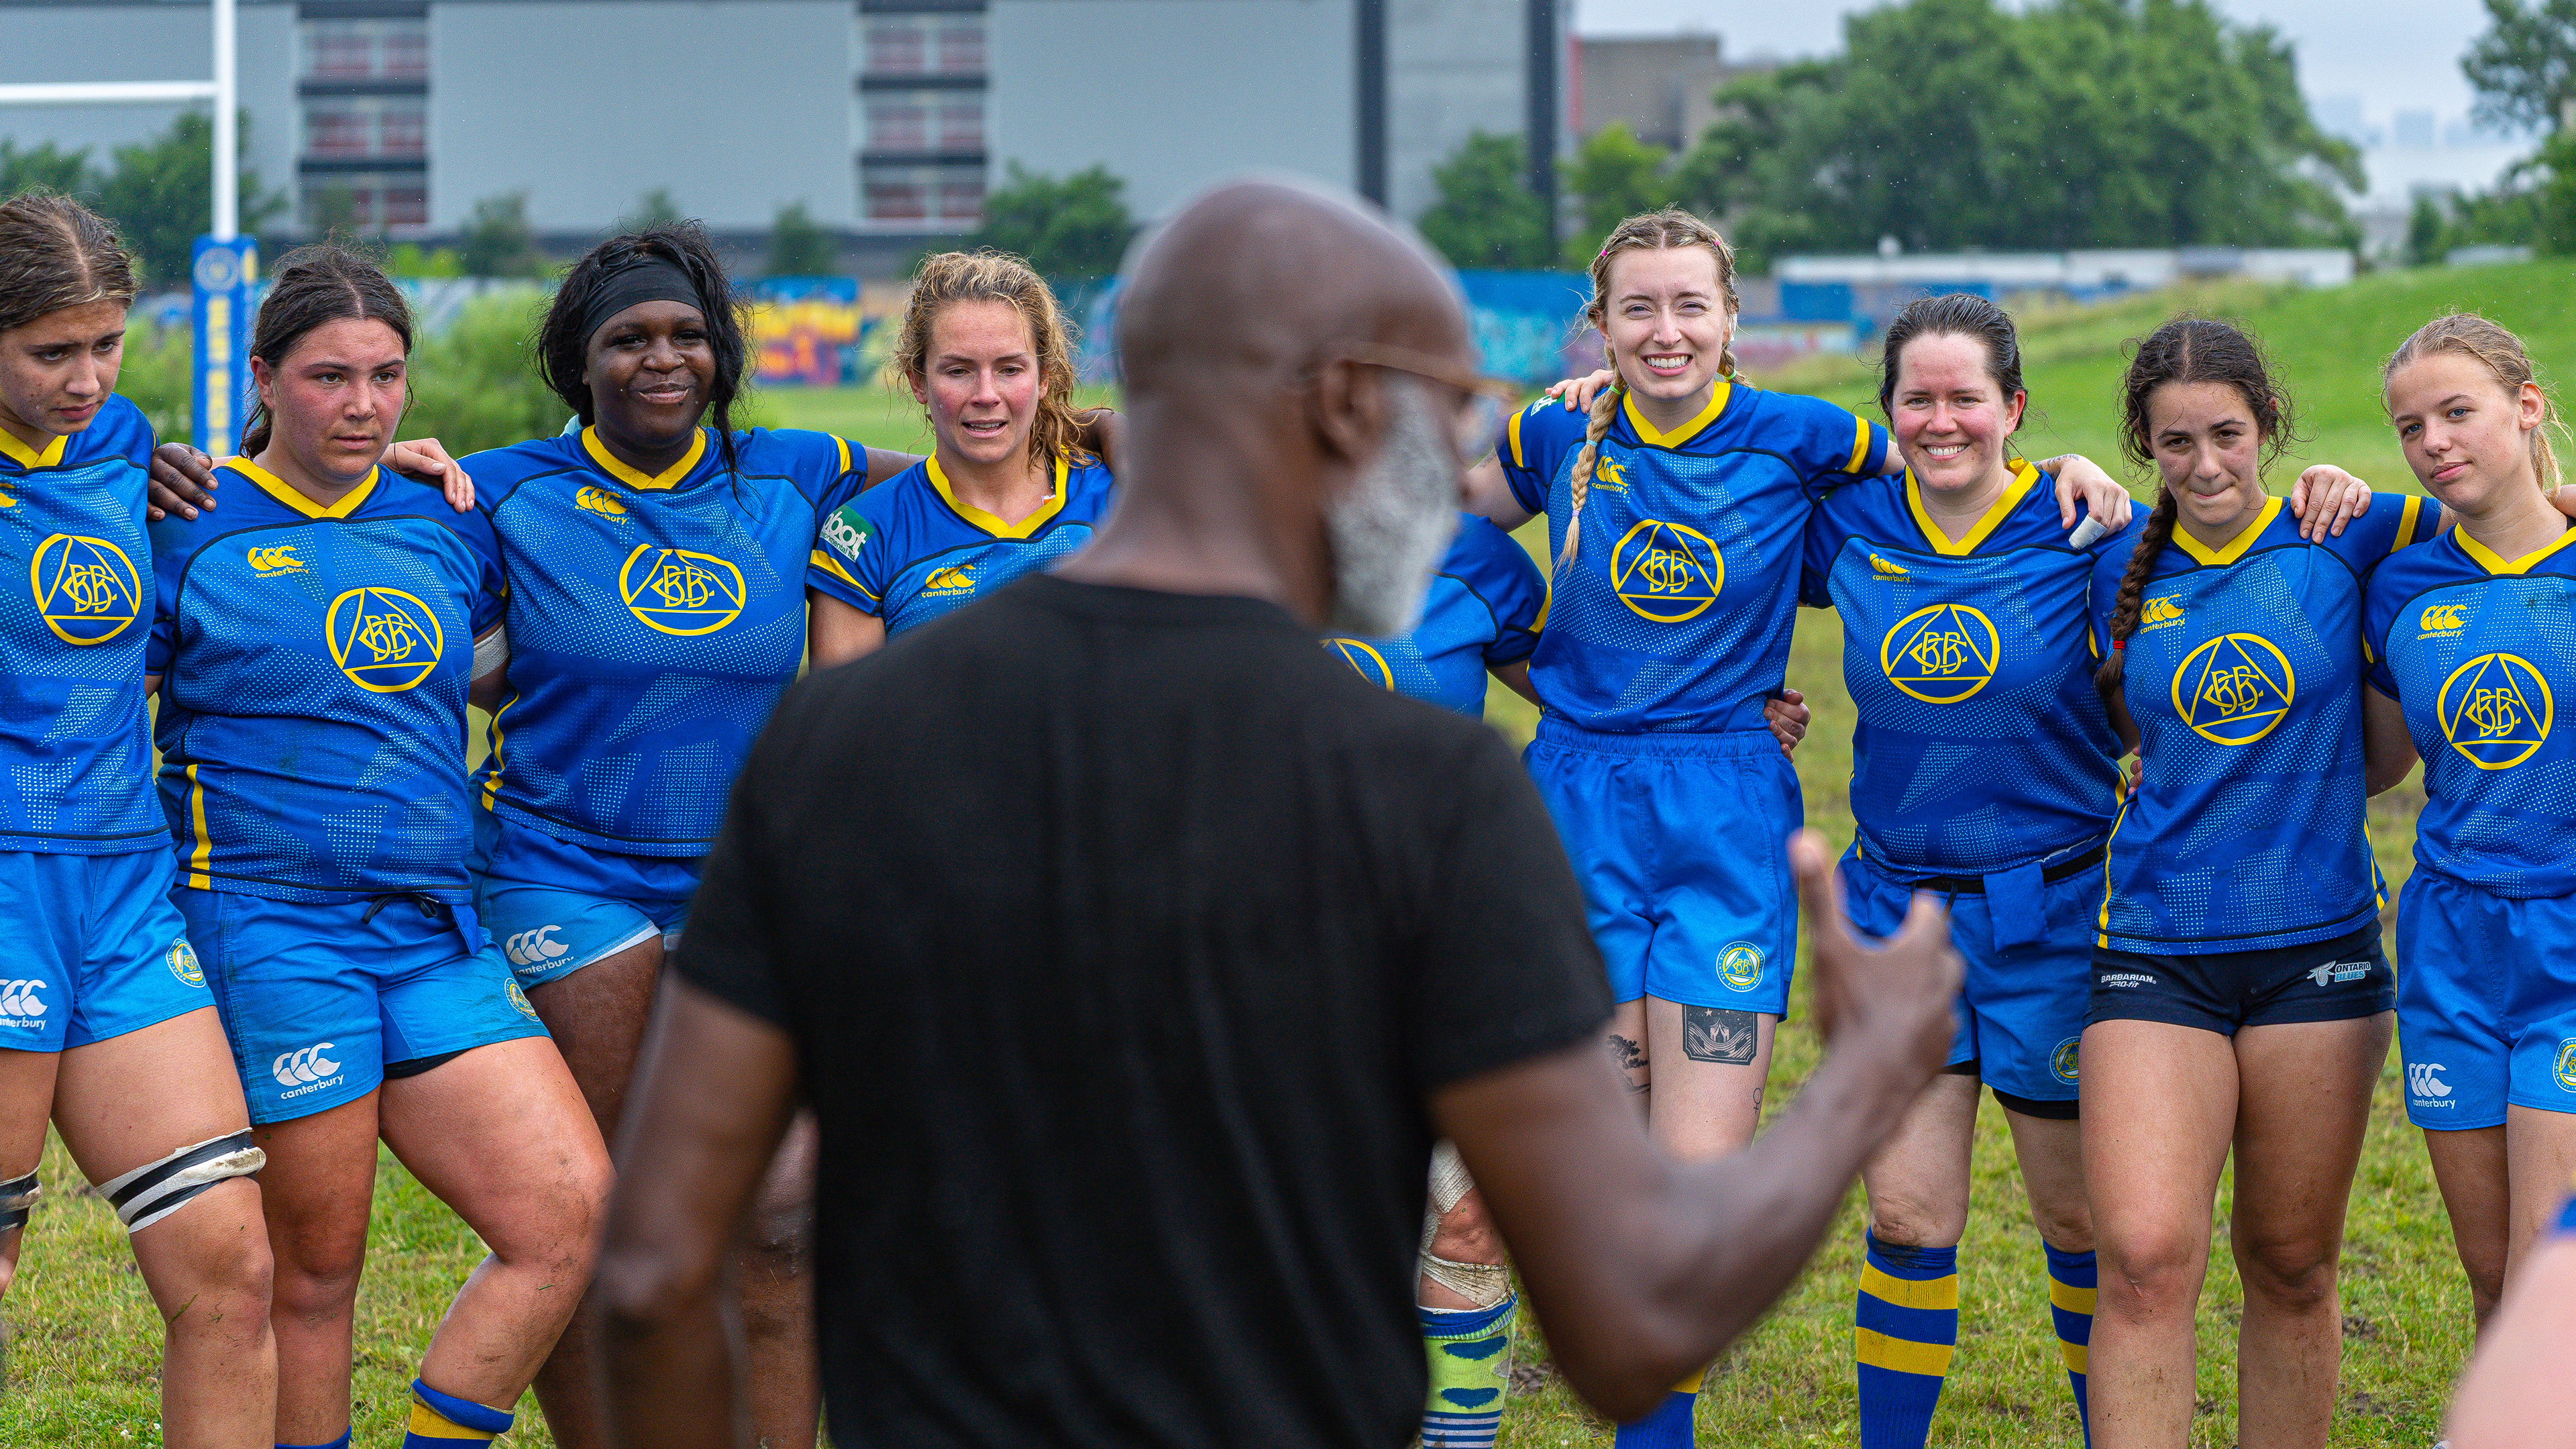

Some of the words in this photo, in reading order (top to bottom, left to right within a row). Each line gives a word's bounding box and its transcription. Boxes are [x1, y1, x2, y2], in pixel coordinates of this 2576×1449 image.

[256, 566, 309, 578] canterbury
[1873, 574, 1911, 584] canterbury
[921, 588, 975, 598] canterbury
[2140, 618, 2186, 634] canterbury
[2417, 630, 2463, 640] canterbury
[2335, 961, 2371, 973] ONTARIO
[2101, 973, 2153, 983] BARBARIAN
[2334, 970, 2365, 982] BLUES
[280, 1073, 344, 1099] canterbury
[2412, 1097, 2456, 1110] canterbury
